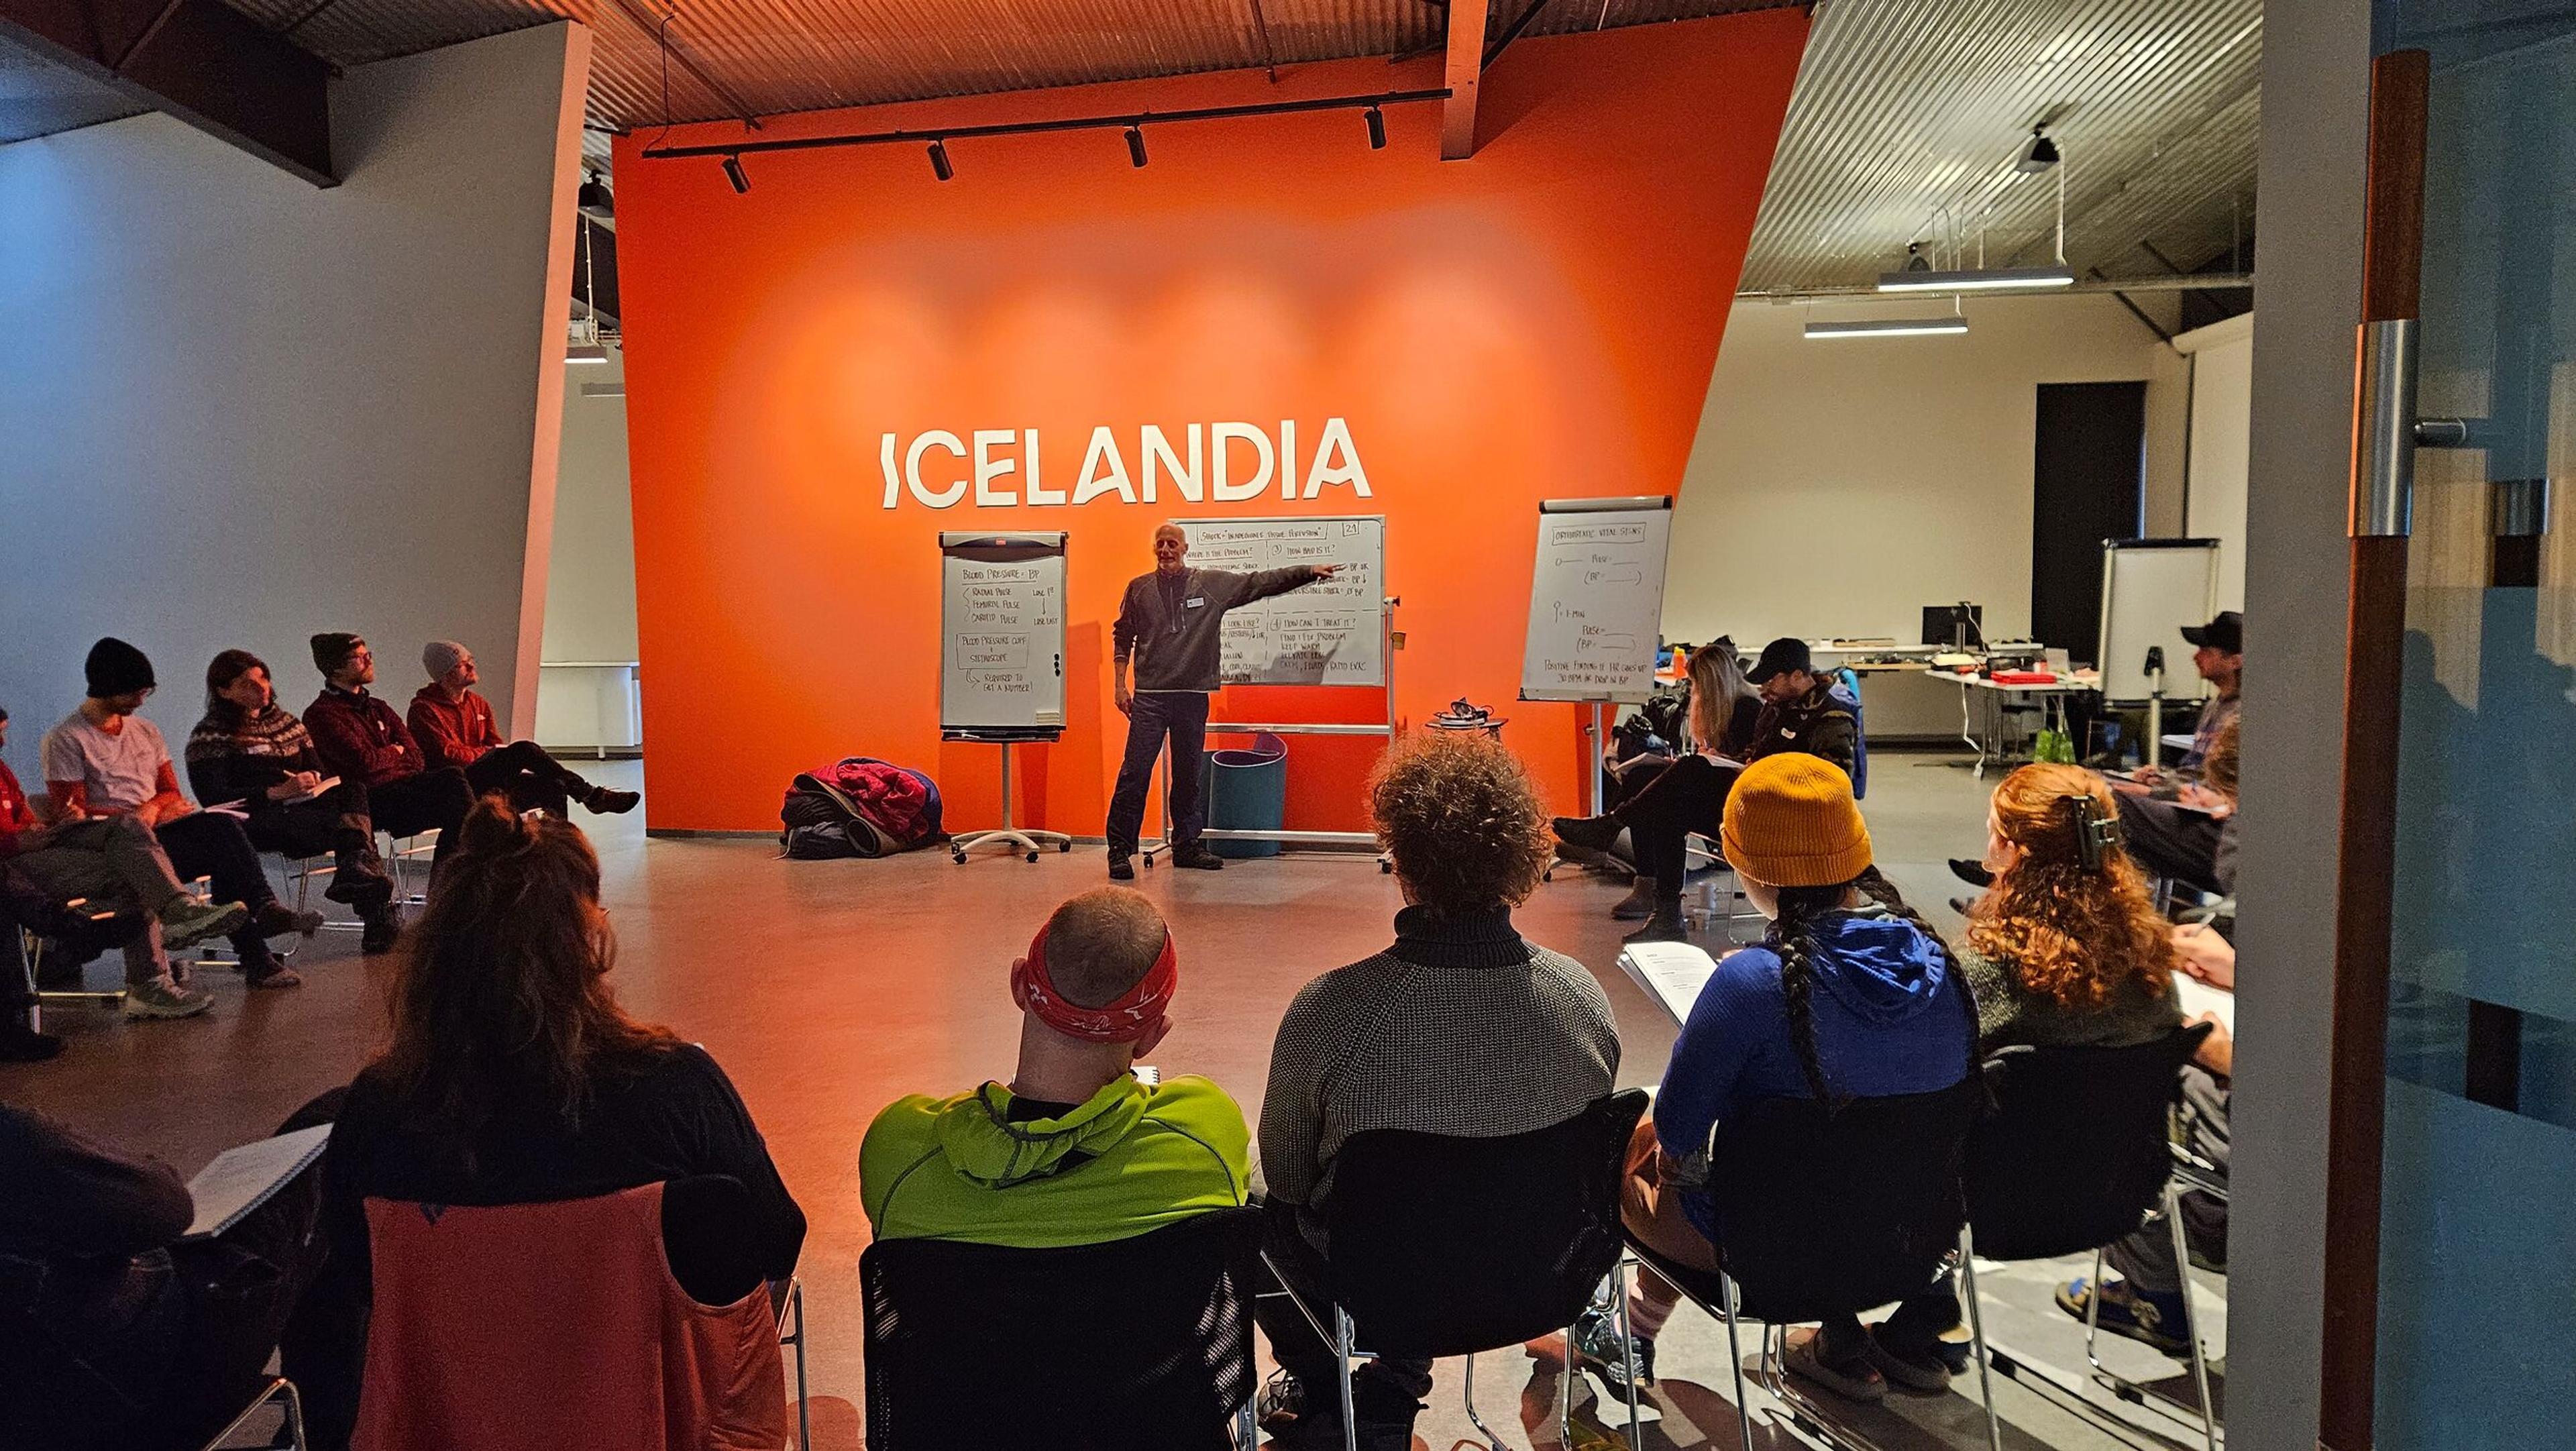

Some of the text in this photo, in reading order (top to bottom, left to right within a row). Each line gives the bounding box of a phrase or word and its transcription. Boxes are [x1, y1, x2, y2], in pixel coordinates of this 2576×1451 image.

[880, 417, 1373, 509] ICELANDIA
[963, 569, 984, 580] BLOOD
[1028, 569, 1040, 580] BP
[972, 588, 1012, 596] RADIAL PULSE
[1003, 600, 1020, 609] PULSE
[1000, 614, 1018, 625] PULSE
[962, 636, 979, 645] BLOOD
[981, 635, 1009, 645] PRESSURE
[1301, 643, 1320, 651] WARM
